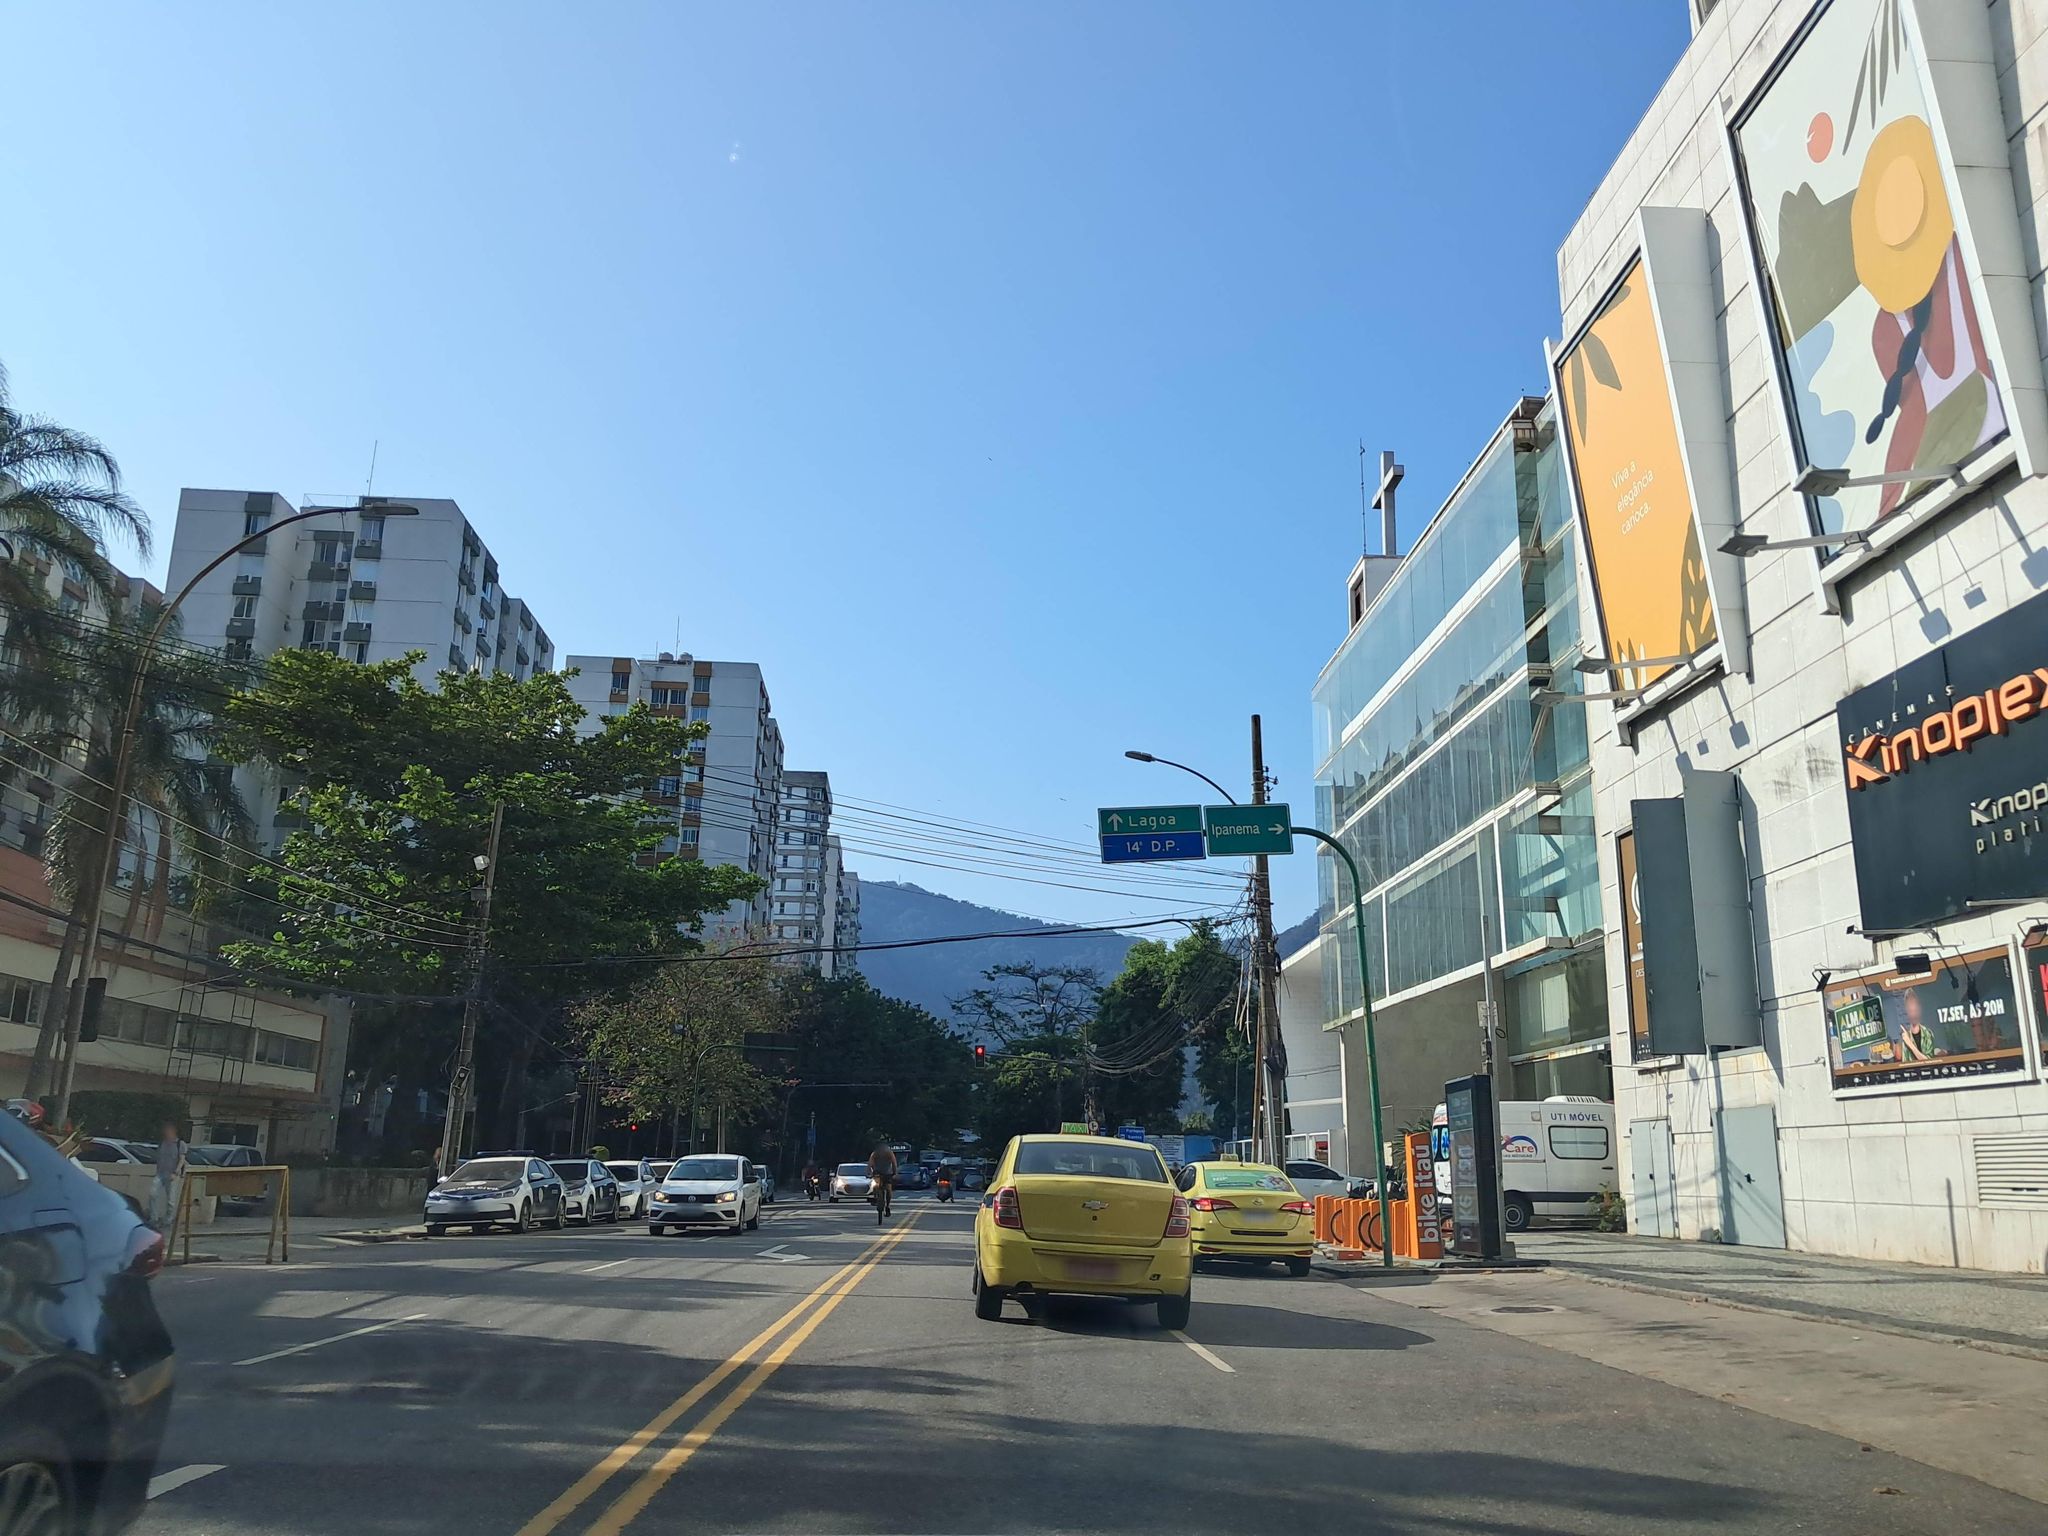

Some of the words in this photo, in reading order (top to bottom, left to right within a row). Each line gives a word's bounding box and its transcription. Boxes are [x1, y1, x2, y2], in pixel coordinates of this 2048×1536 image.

[1611, 467, 1629, 489] Viva
[1617, 469, 1654, 513] elegância
[1621, 502, 1652, 535] carioca.
[1848, 684, 1955, 744] CINEMAS
[1128, 814, 1177, 830] Lagoa
[1211, 823, 1261, 838] Ipanema
[1151, 840, 1180, 852] D.P.
[1840, 1009, 1865, 1030] ALMA
[1867, 1003, 1880, 1021] DE
[1983, 999, 2005, 1017] 20H
[1841, 1020, 1882, 1044] BRASILEIRO
[1550, 1113, 1567, 1121] UTI
[1569, 1112, 1605, 1122] MÓVEL
[1505, 1144, 1534, 1153] Care
[1411, 1144, 1433, 1188] itaú
[1417, 1193, 1440, 1243] bike
